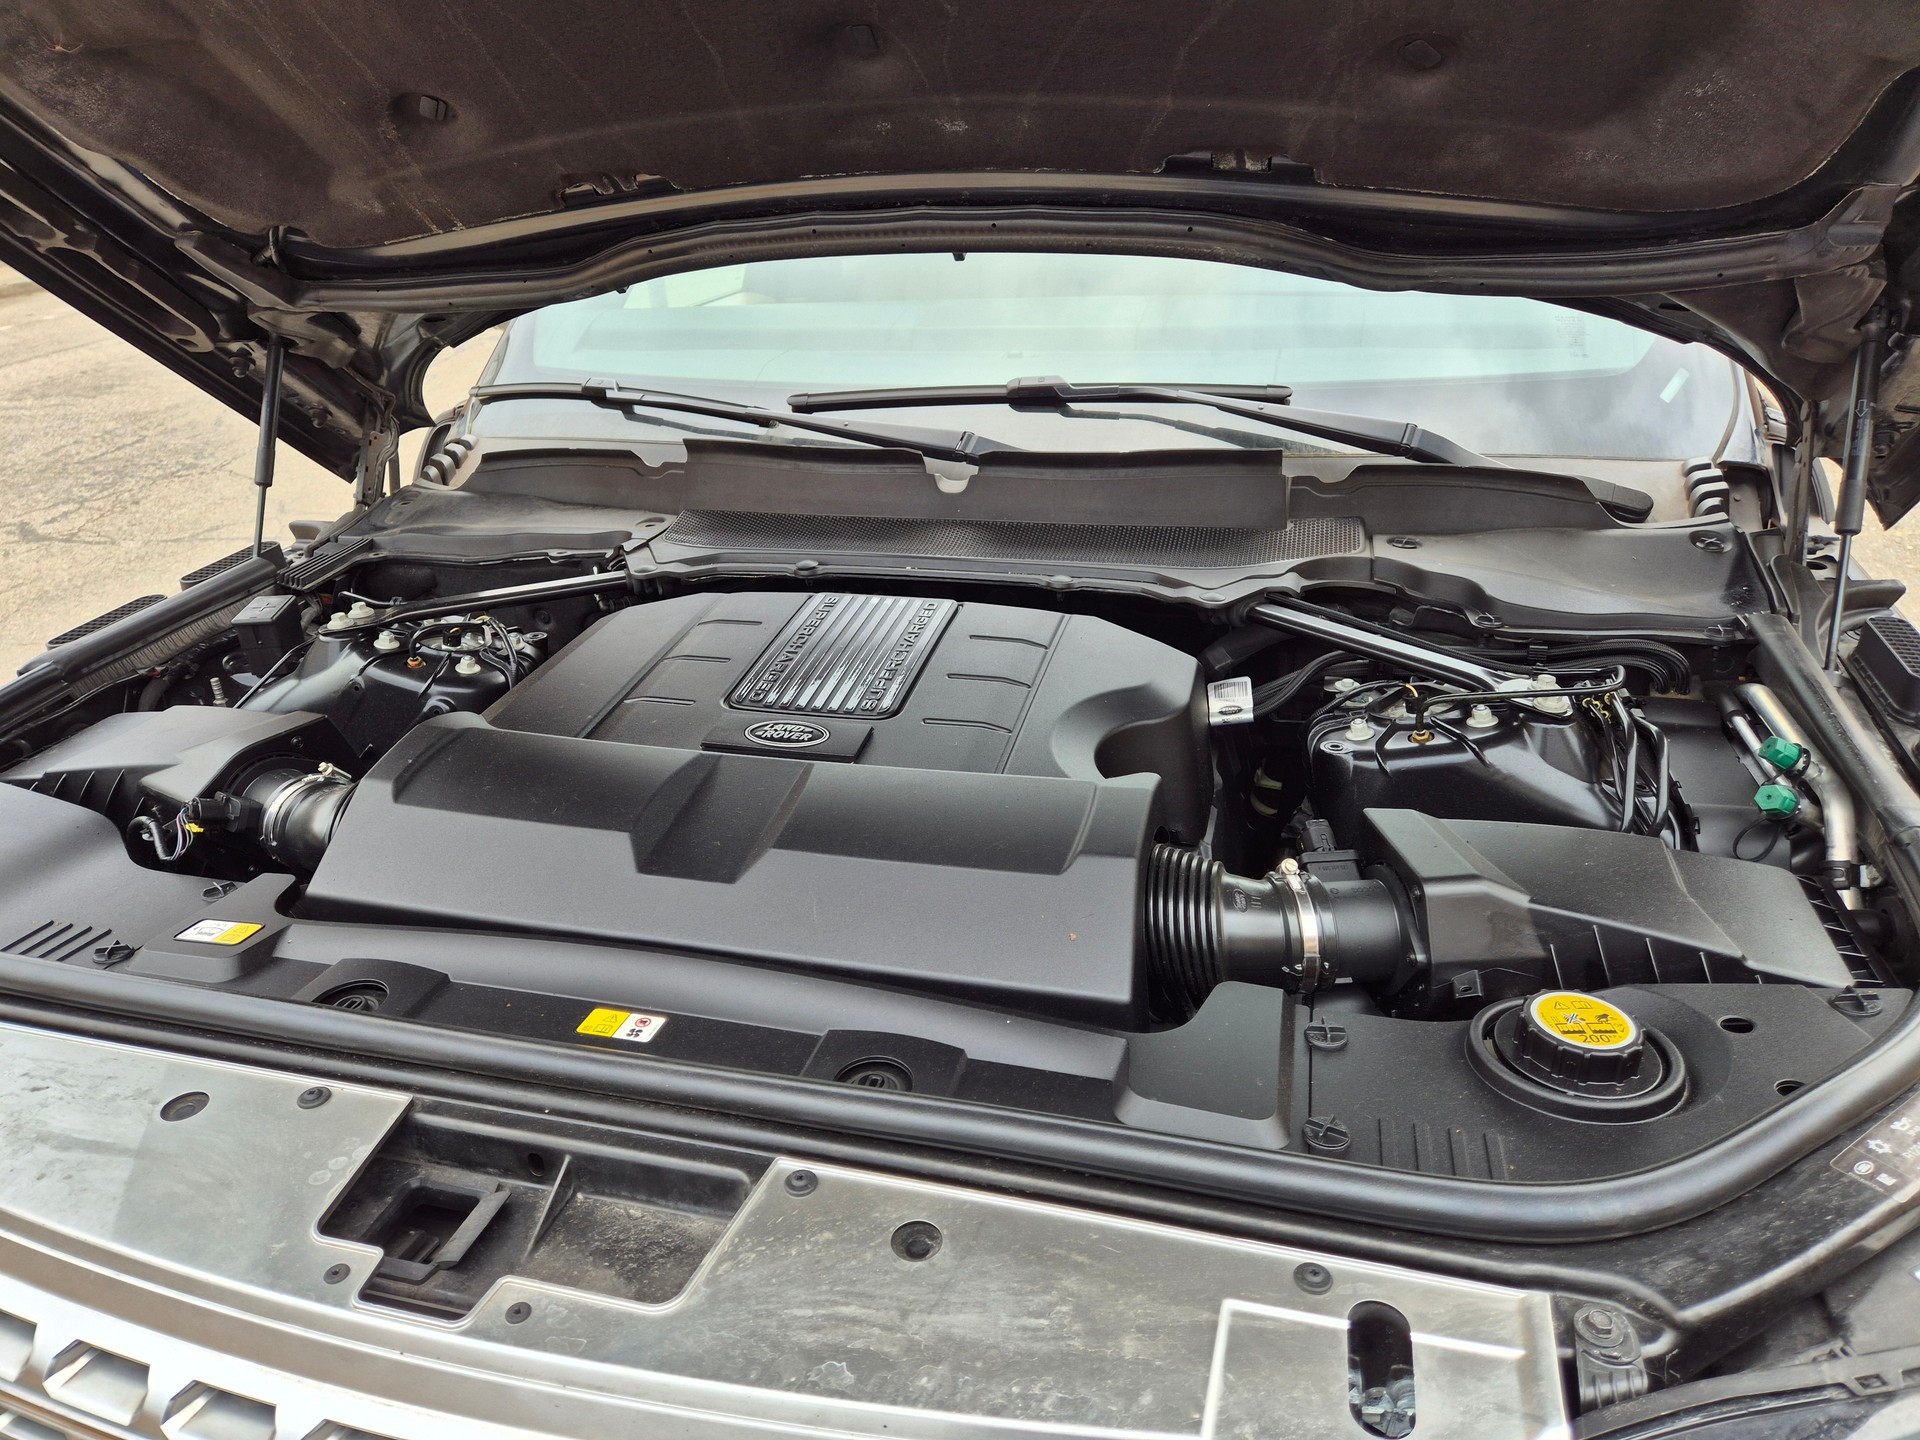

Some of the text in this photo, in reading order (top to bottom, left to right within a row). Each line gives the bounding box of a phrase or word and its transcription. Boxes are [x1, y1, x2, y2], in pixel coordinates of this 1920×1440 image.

[749, 595, 840, 701] SUPERCHARGED
[860, 601, 938, 712] SUPERCHARGED
[763, 723, 806, 732] LAND
[761, 730, 813, 741] ROVER
[1579, 1034, 1611, 1043] 200
